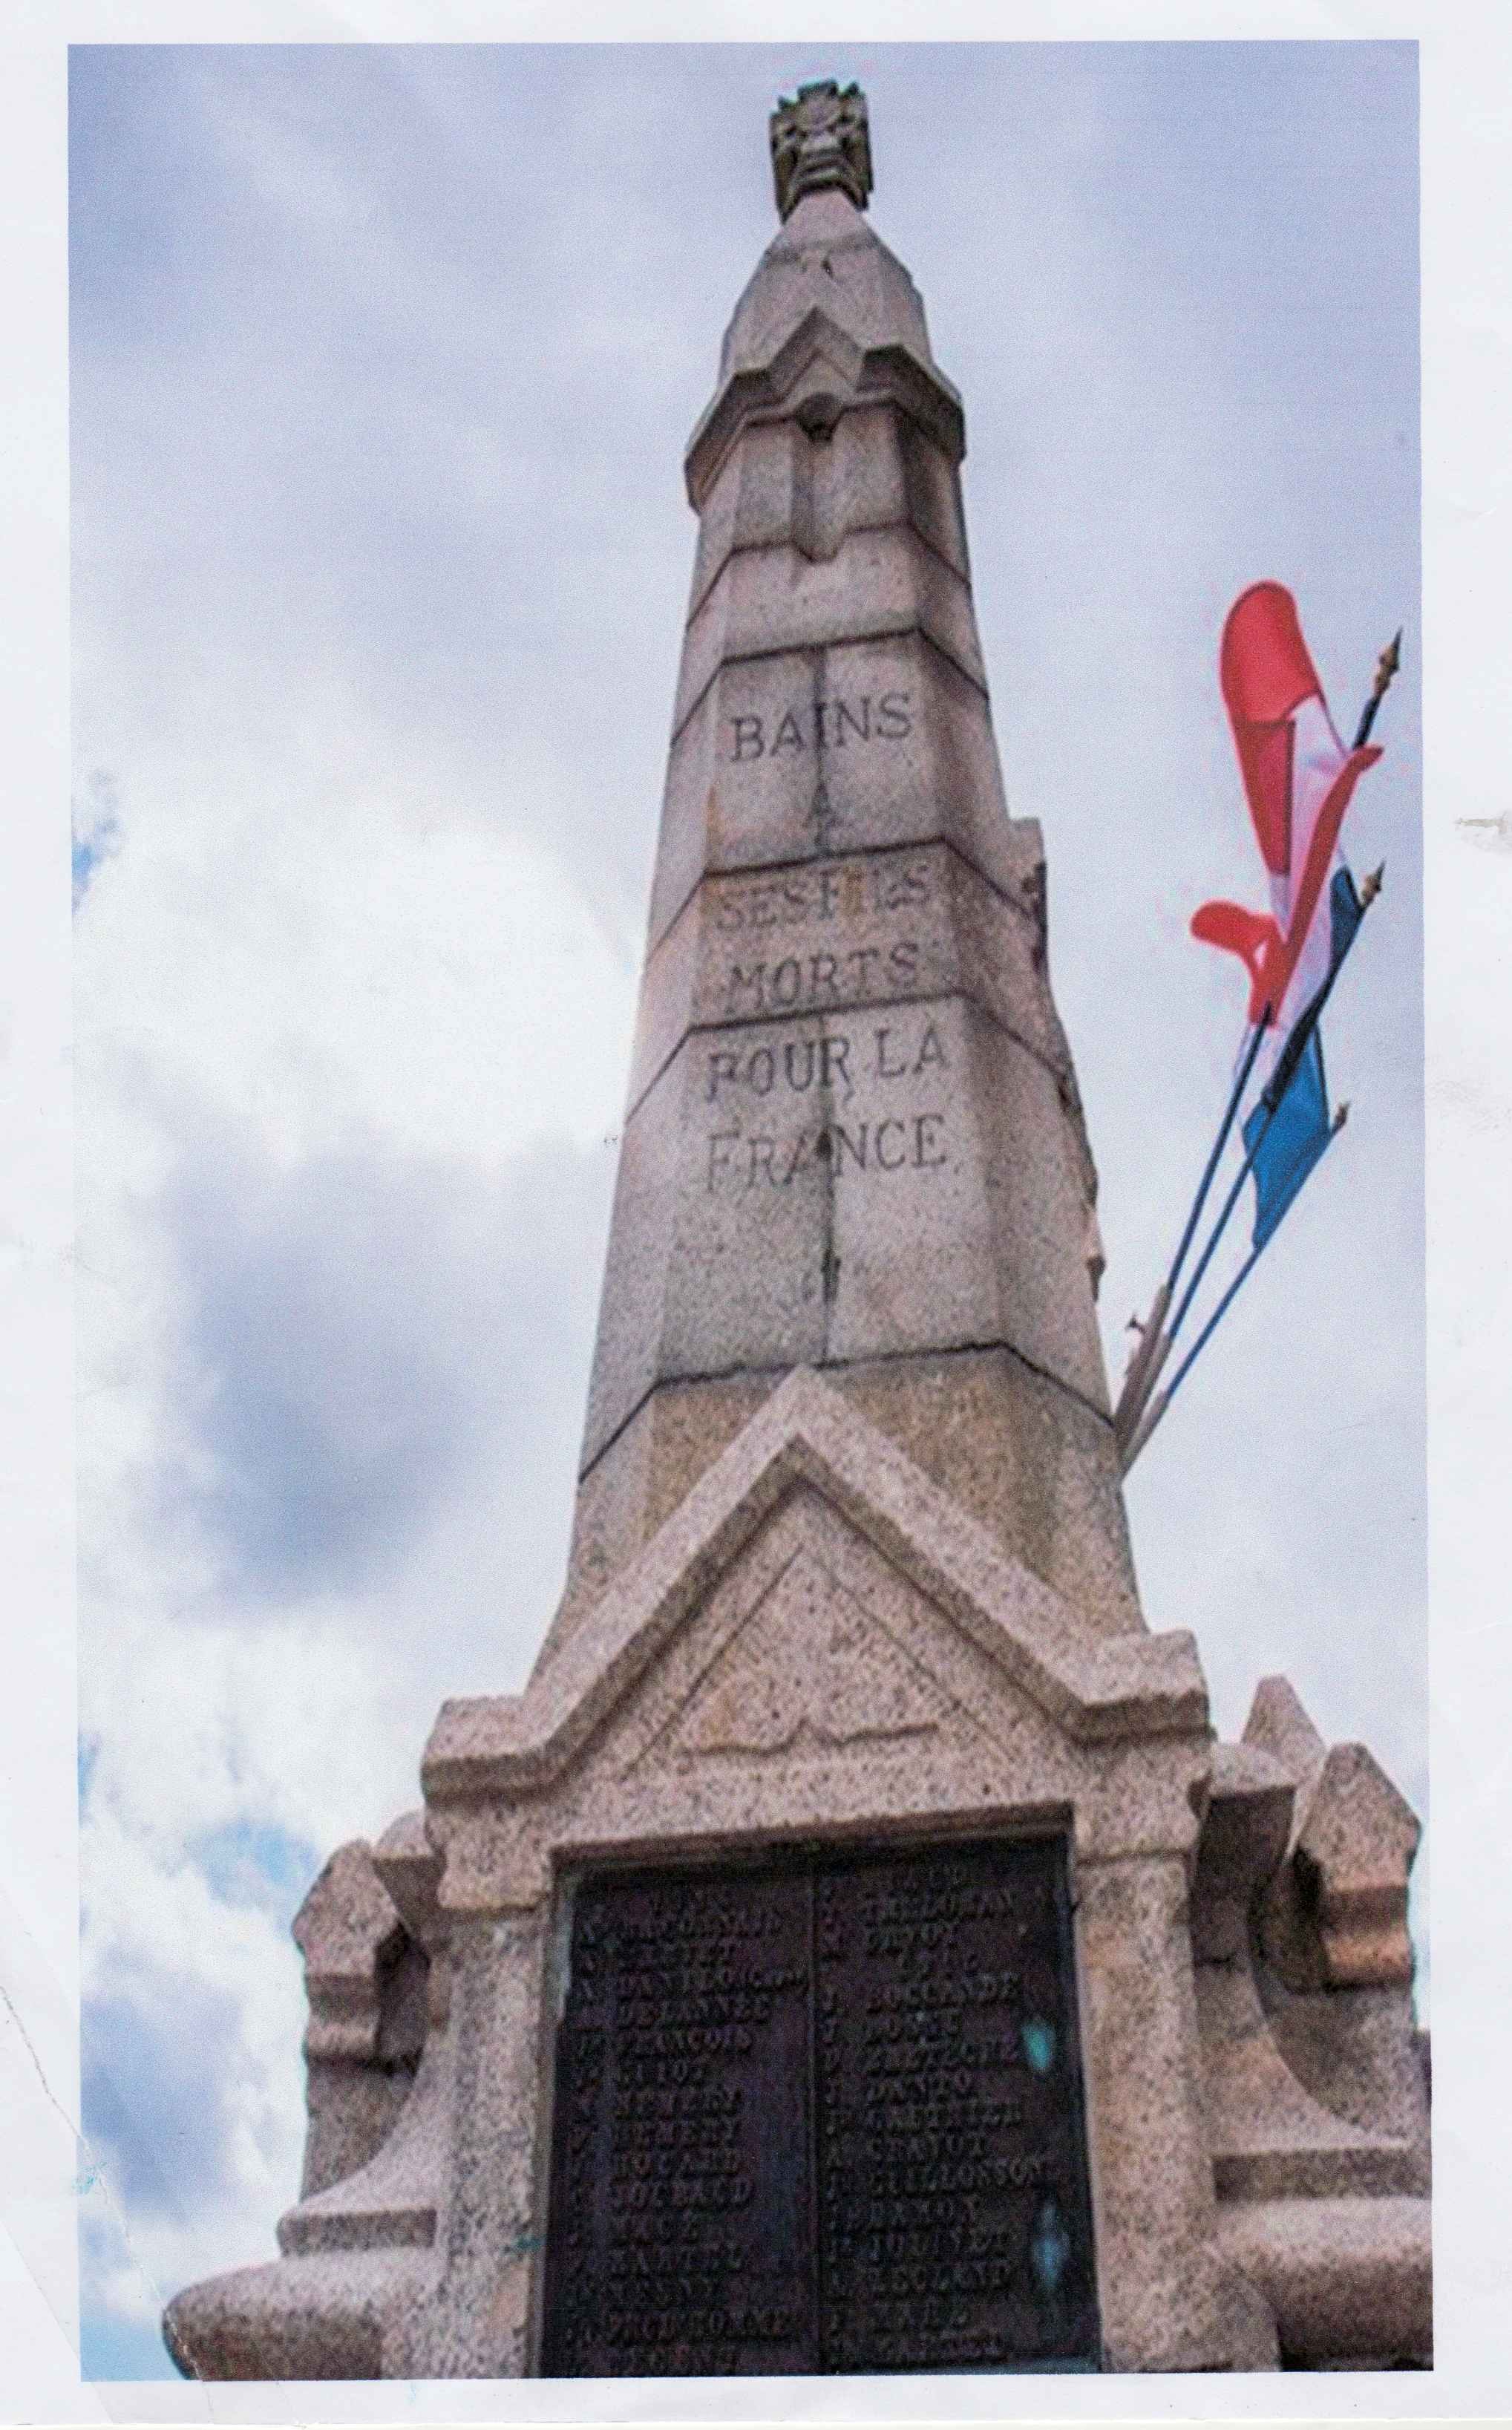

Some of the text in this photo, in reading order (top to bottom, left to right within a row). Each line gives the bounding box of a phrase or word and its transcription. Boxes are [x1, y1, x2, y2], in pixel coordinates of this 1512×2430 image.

[730, 690, 912, 762] BAINS
[714, 879, 809, 930] SES
[729, 941, 918, 1011] MORTS
[706, 1022, 945, 1103] POUR LA
[707, 1113, 947, 1191] FRANCE
